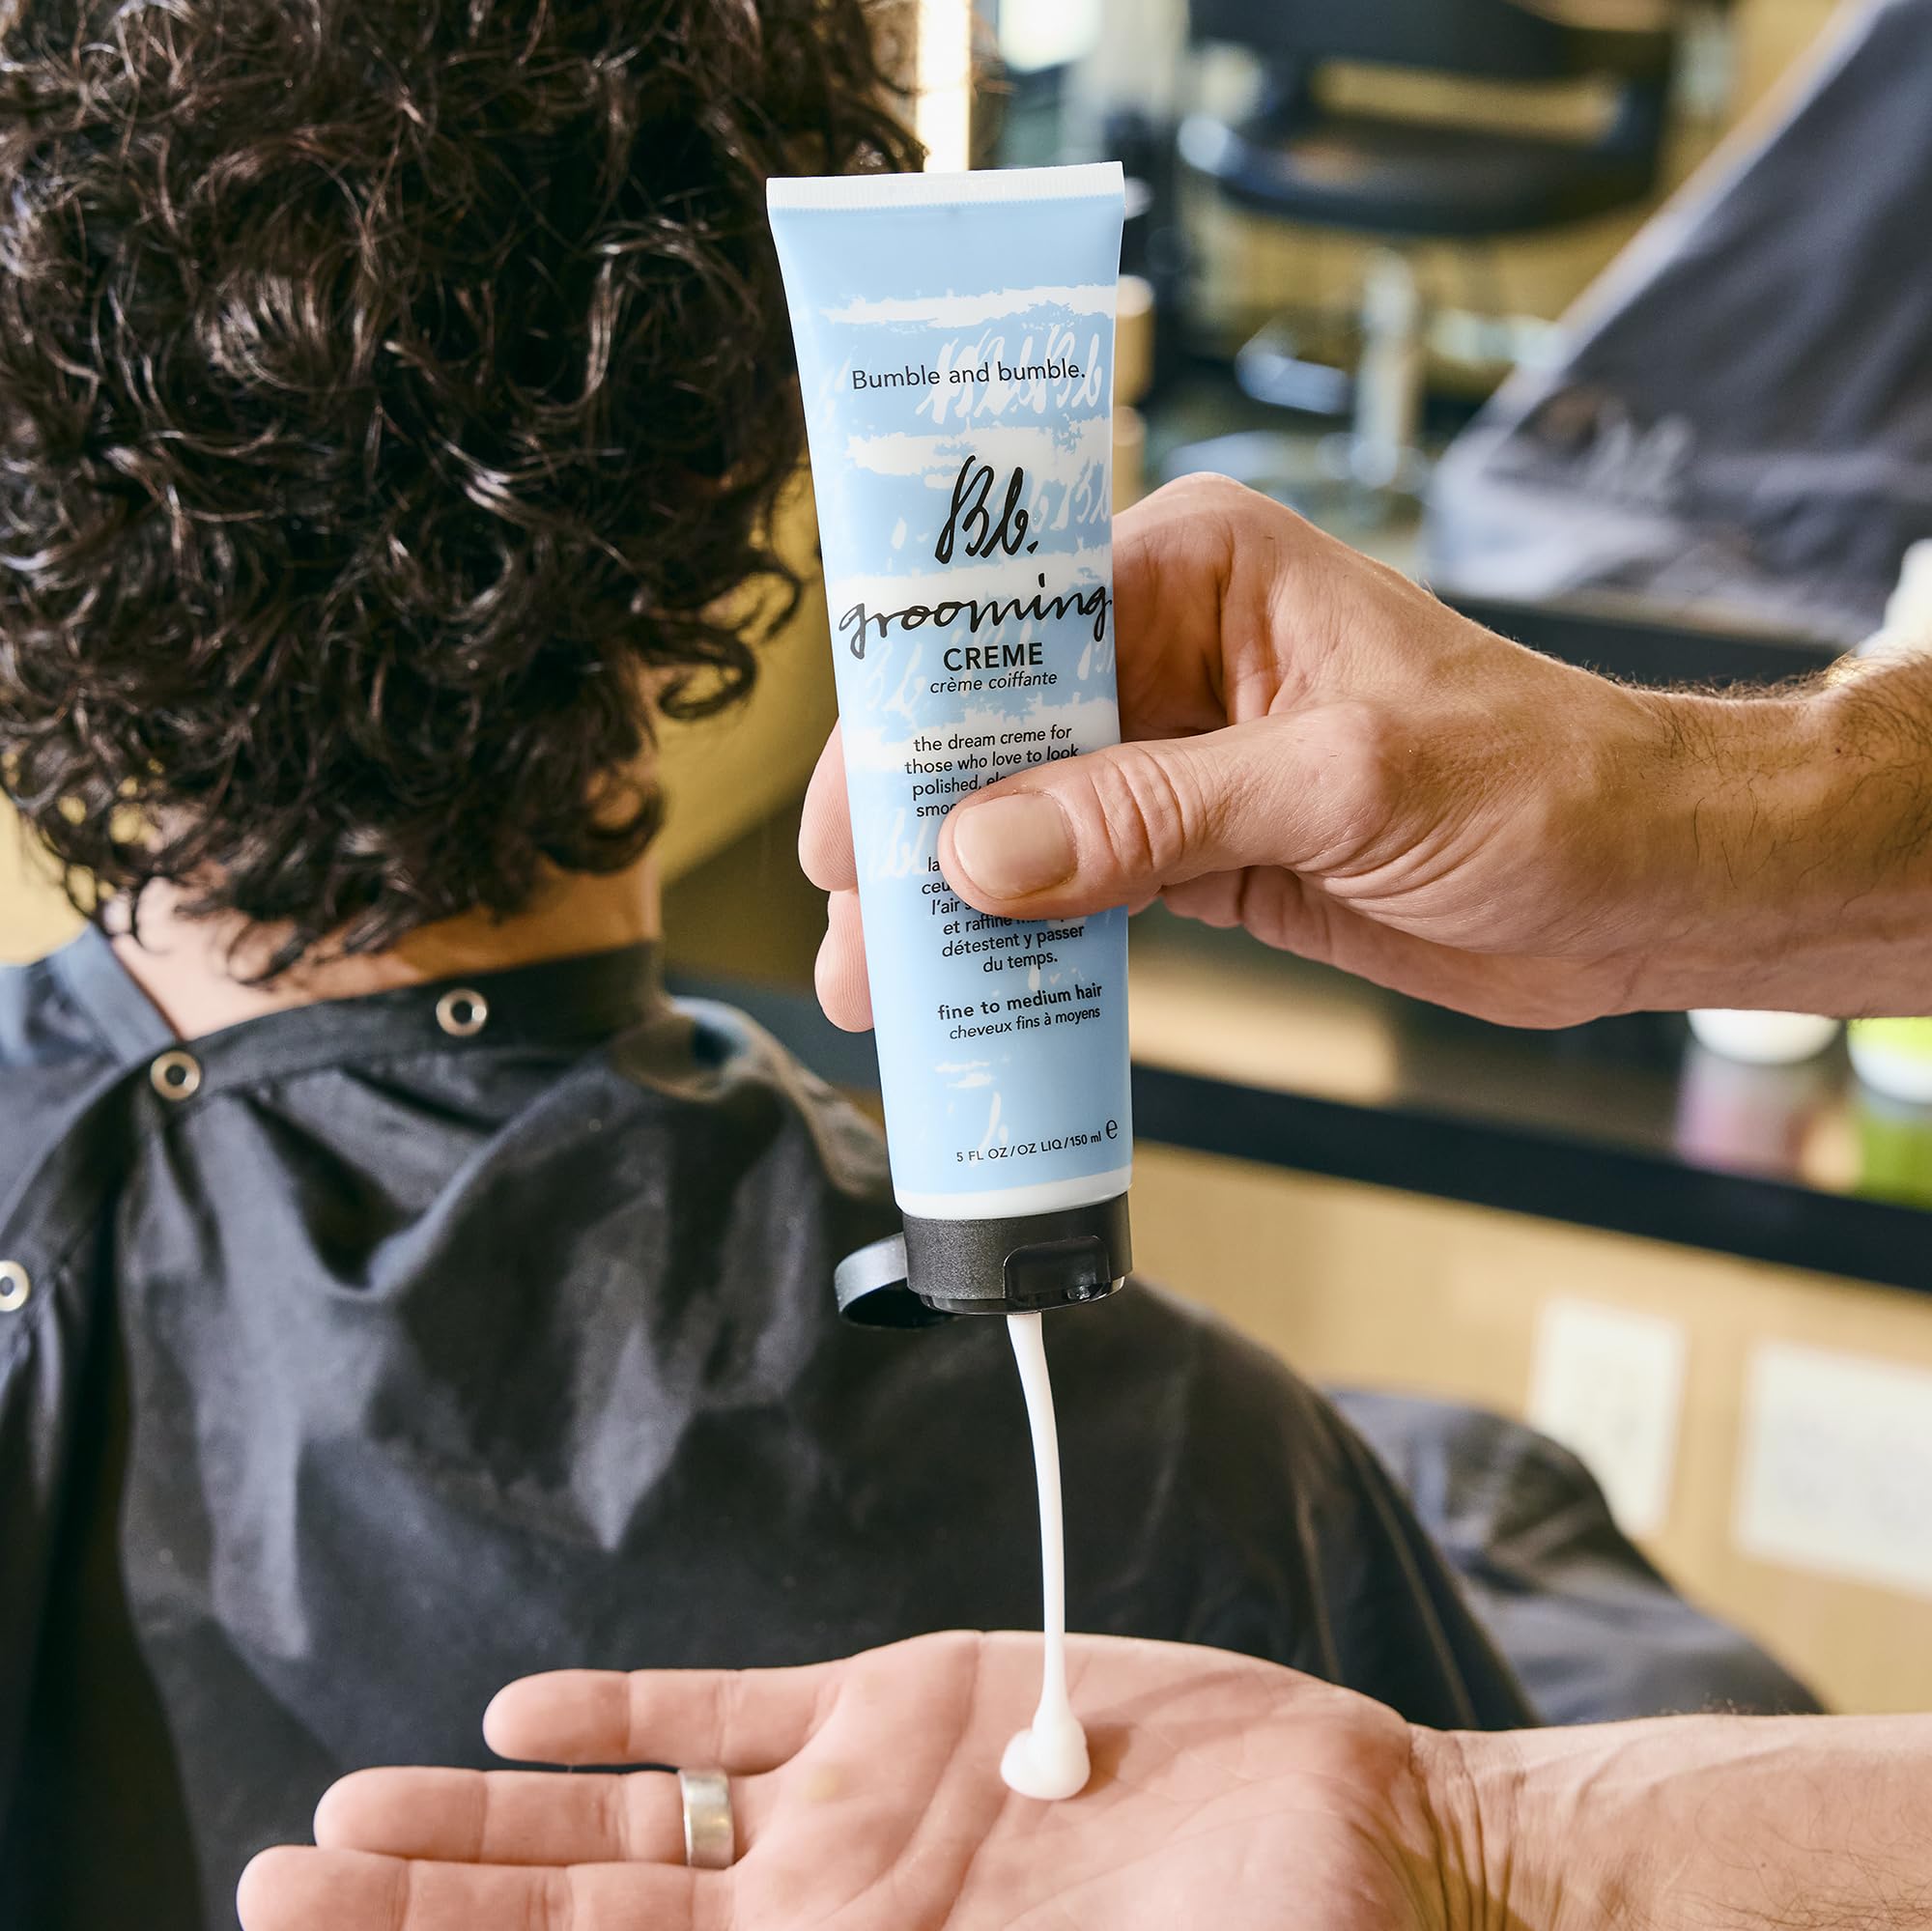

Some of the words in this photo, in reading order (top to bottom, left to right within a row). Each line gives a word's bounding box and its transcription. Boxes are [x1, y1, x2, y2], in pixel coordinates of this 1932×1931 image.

[852, 364, 941, 389] Bumble
[949, 361, 990, 383] and
[997, 357, 1086, 382] bumble.
[838, 573, 1112, 660] grooming
[943, 641, 1043, 671] CREME
[930, 676, 982, 694] crème
[988, 670, 1058, 690] coiffante
[913, 736, 942, 752] the
[948, 733, 996, 750] dream
[1000, 730, 1045, 746] creme
[1051, 724, 1072, 741] for
[904, 758, 952, 775] those
[957, 753, 987, 771] who
[992, 752, 1022, 767] love
[1026, 750, 1042, 762] to
[1046, 743, 1079, 761] look
[913, 774, 981, 801] polished,
[922, 882, 952, 895] ceu
[932, 897, 960, 915] l'air
[942, 933, 1020, 956] détestent
[1024, 933, 1033, 949] y
[1037, 924, 1085, 948] passer
[943, 923, 960, 935] et
[982, 956, 1003, 973] du
[1007, 951, 1059, 971] temps.
[937, 1005, 975, 1020] fine
[980, 1001, 1001, 1015] to
[1007, 989, 1071, 1011] medium
[1074, 982, 1102, 1000] hair
[950, 1020, 1012, 1040] cheveux
[1016, 1015, 1040, 1030] fins
[1044, 1012, 1052, 1026] à
[1055, 1007, 1100, 1026] moyens
[956, 1151, 964, 1162] 5
[968, 1150, 983, 1161] FL
[1091, 1130, 1102, 1144] ml
